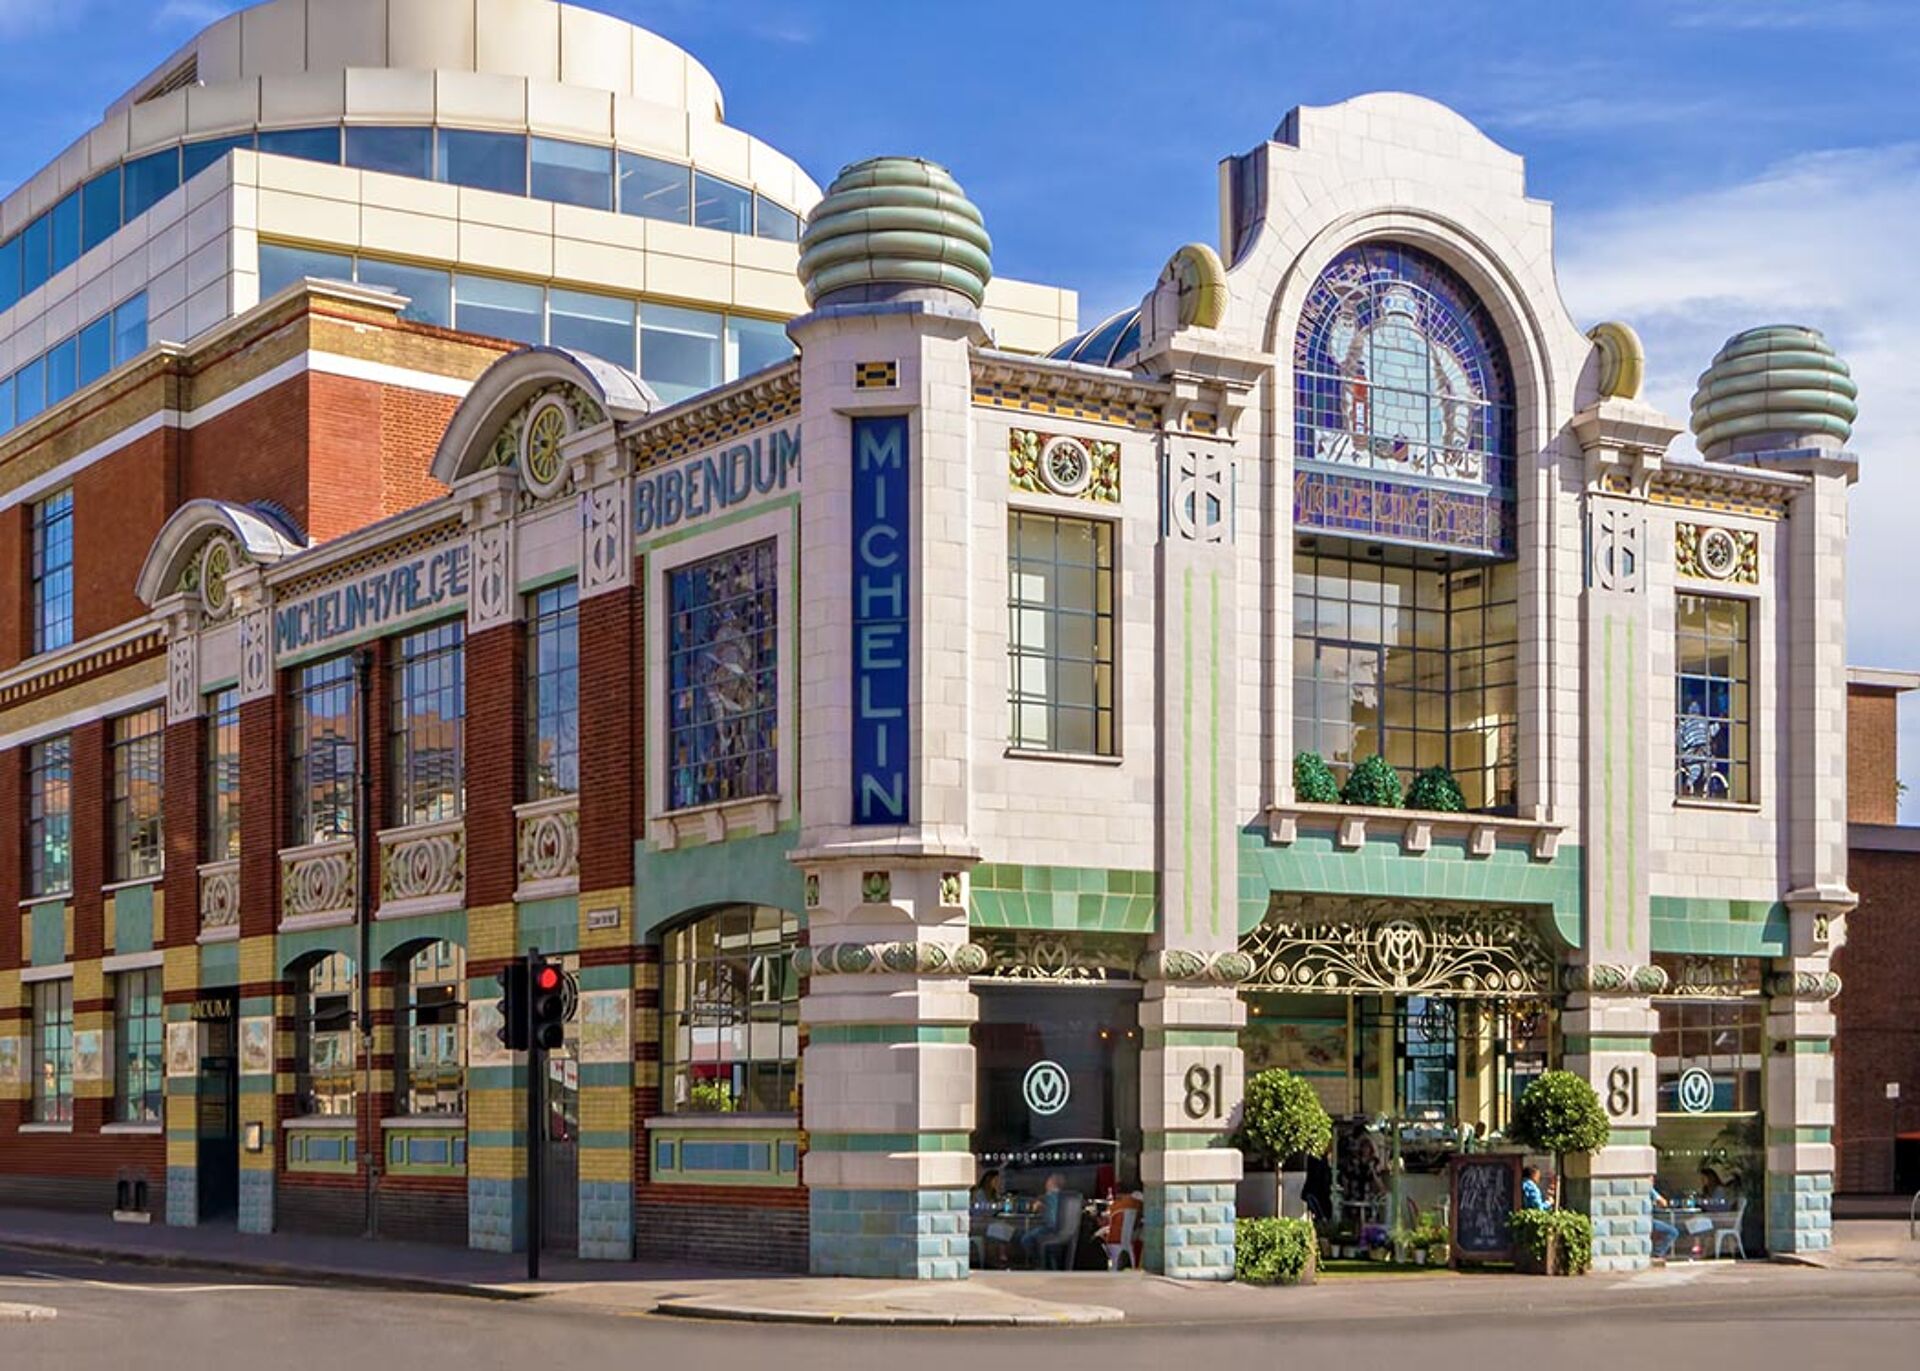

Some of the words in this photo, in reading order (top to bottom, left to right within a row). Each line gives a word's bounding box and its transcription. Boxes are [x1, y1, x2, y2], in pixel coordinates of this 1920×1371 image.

[635, 424, 802, 535] BIBENDUM
[859, 427, 903, 818] MICHELIN
[1184, 1063, 1223, 1119] 81
[1606, 1065, 1639, 1117] 81
